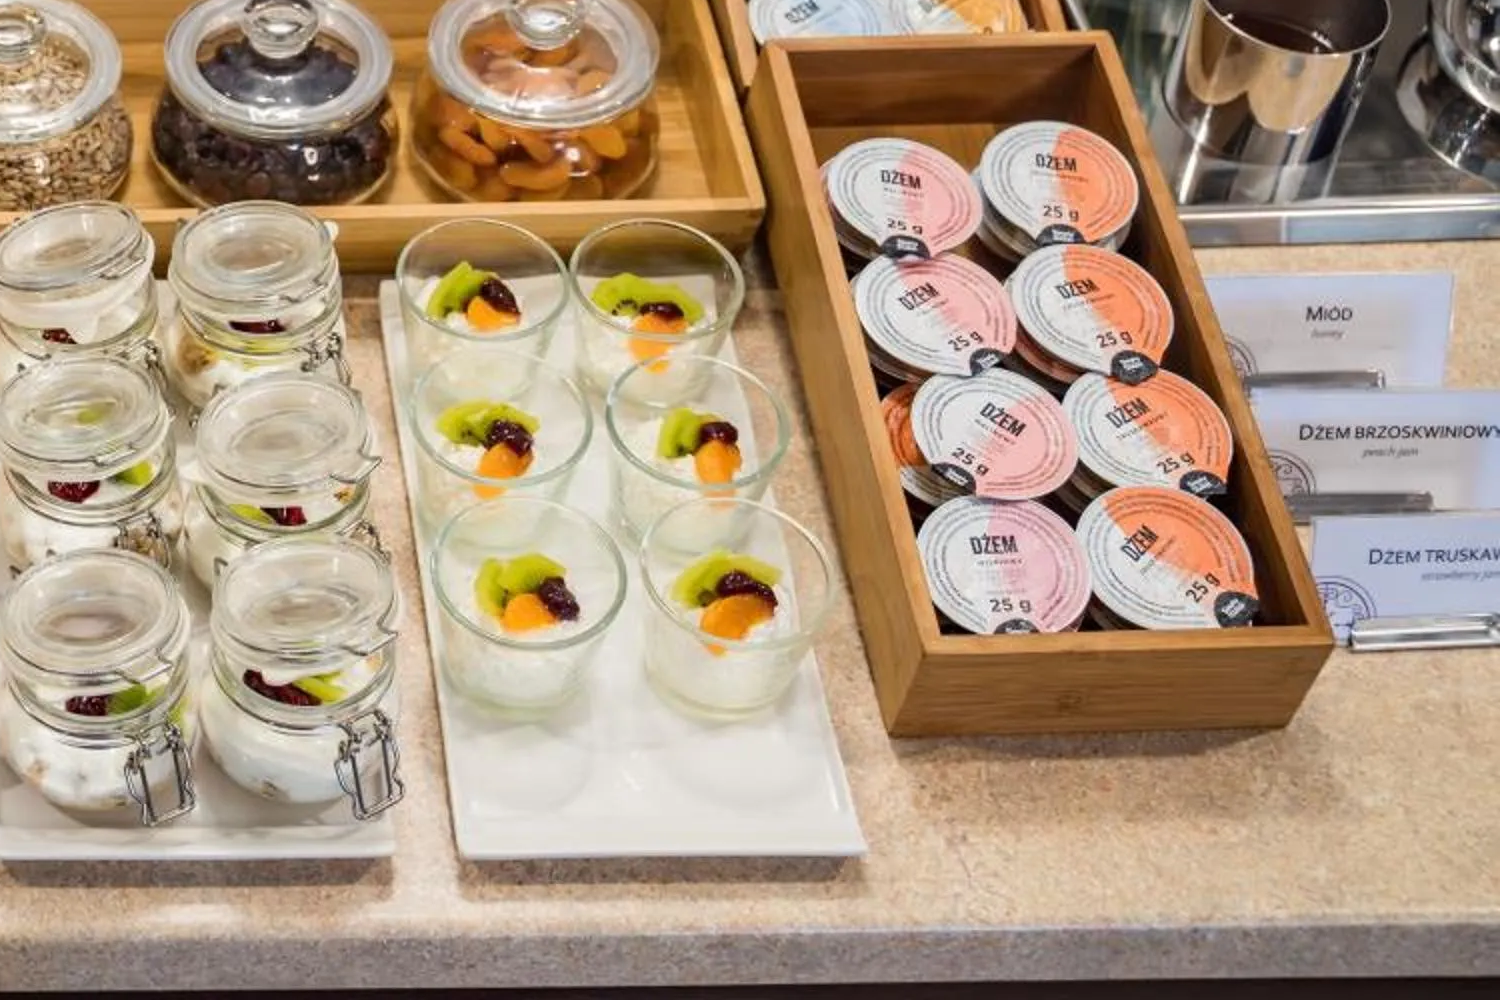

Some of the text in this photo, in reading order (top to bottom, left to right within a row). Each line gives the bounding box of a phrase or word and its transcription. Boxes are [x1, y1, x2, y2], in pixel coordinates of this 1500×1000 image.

[881, 168, 922, 189] DŻEM
[1043, 204, 1080, 223] 25 g
[886, 217, 923, 236] 25 g
[947, 331, 984, 352] 25 g
[1096, 331, 1134, 349] 25 g
[979, 400, 1027, 438] DŻEM
[1106, 396, 1151, 430] DŻEM
[1354, 424, 1500, 440] BRZOSKWINIOWY
[951, 447, 974, 466] 25
[977, 463, 991, 478] g
[1156, 451, 1196, 475] 25 g
[969, 532, 1019, 556] DŻEM
[1120, 523, 1160, 563] DŻEM
[1185, 572, 1222, 604] 25 g
[989, 598, 1032, 615] 25 g
